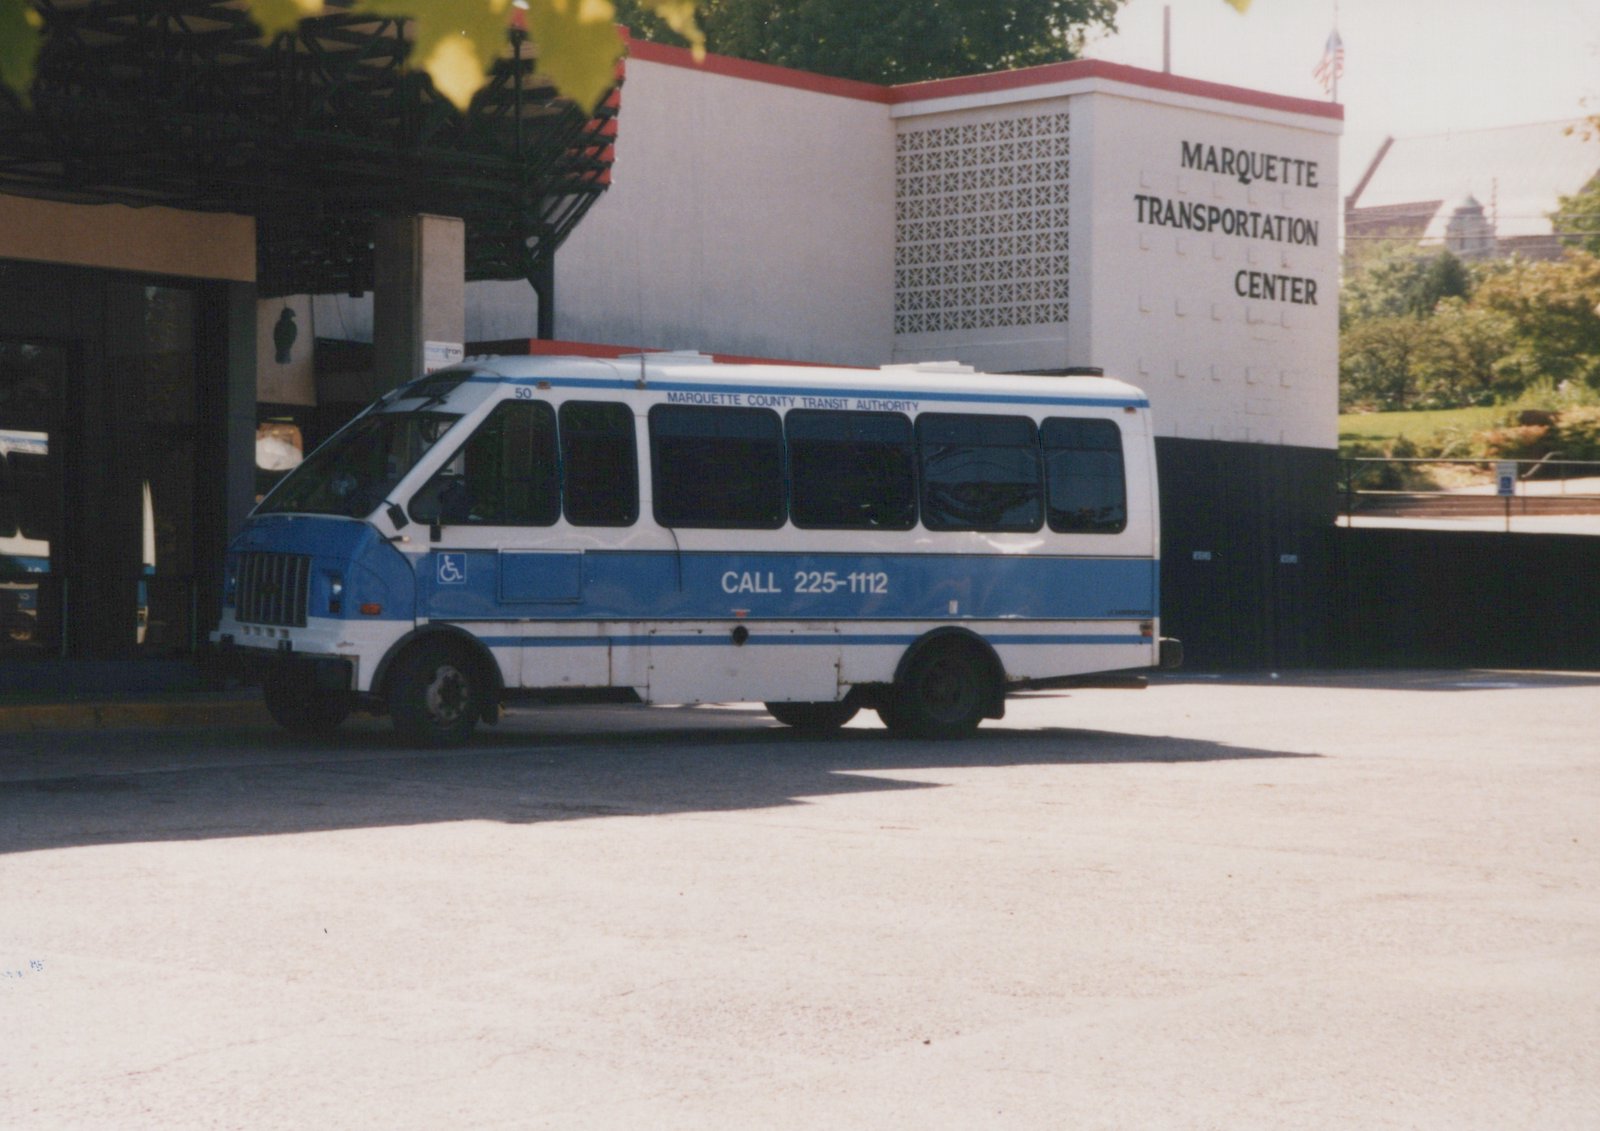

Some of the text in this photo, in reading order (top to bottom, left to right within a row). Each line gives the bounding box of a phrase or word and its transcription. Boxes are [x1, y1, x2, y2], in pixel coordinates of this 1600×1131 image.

[1181, 140, 1319, 188] MARQUETTE
[1134, 194, 1319, 247] TRANSPORTATION
[1234, 269, 1318, 305] CENTER
[515, 387, 532, 399] 50
[667, 391, 919, 412] MARQUETTE COUNTY TRANSIT AUTHORITY
[721, 571, 888, 594] CALL 225-1112
